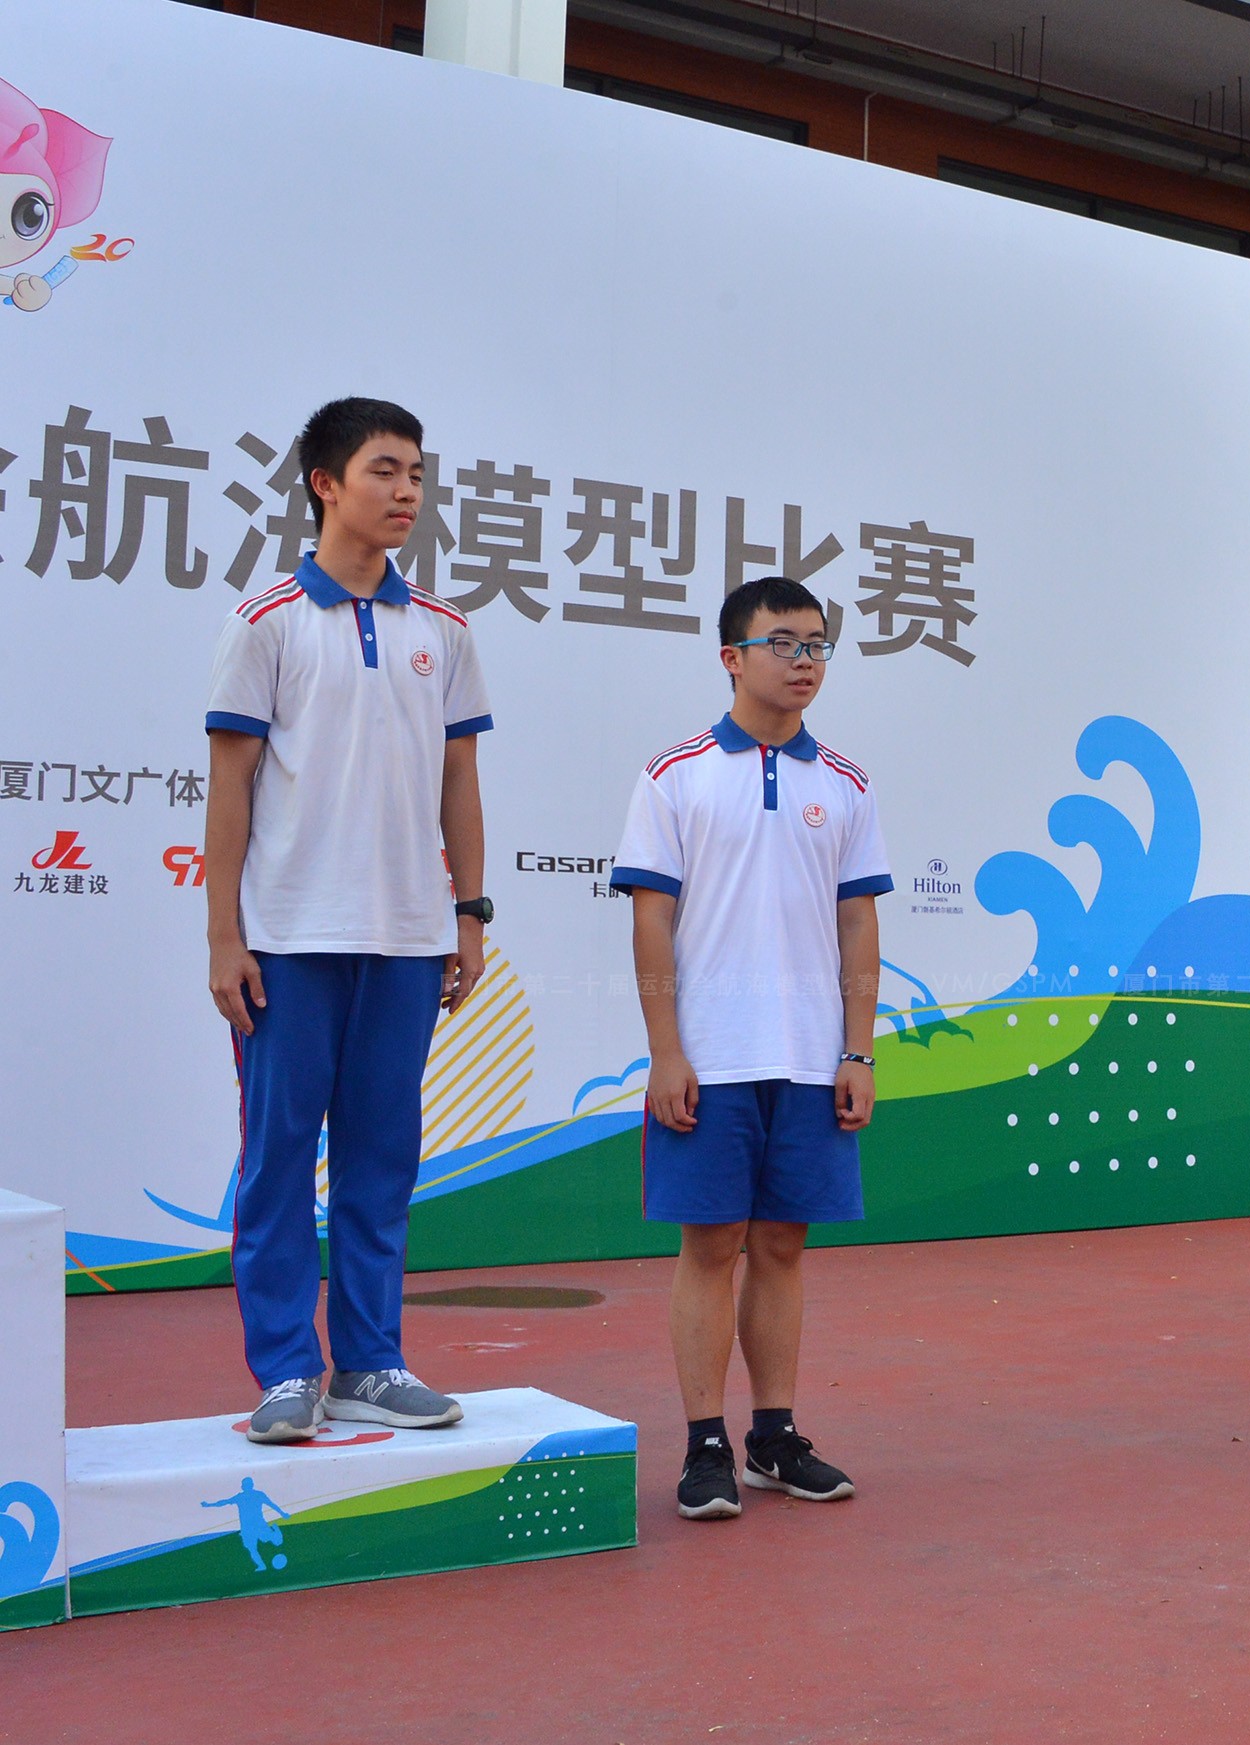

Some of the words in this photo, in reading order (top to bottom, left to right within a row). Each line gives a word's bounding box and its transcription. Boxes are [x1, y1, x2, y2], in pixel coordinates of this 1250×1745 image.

[0, 404, 978, 668] 航海模型比赛
[13, 872, 109, 895] 九龙建设
[913, 877, 961, 894] Hilton
